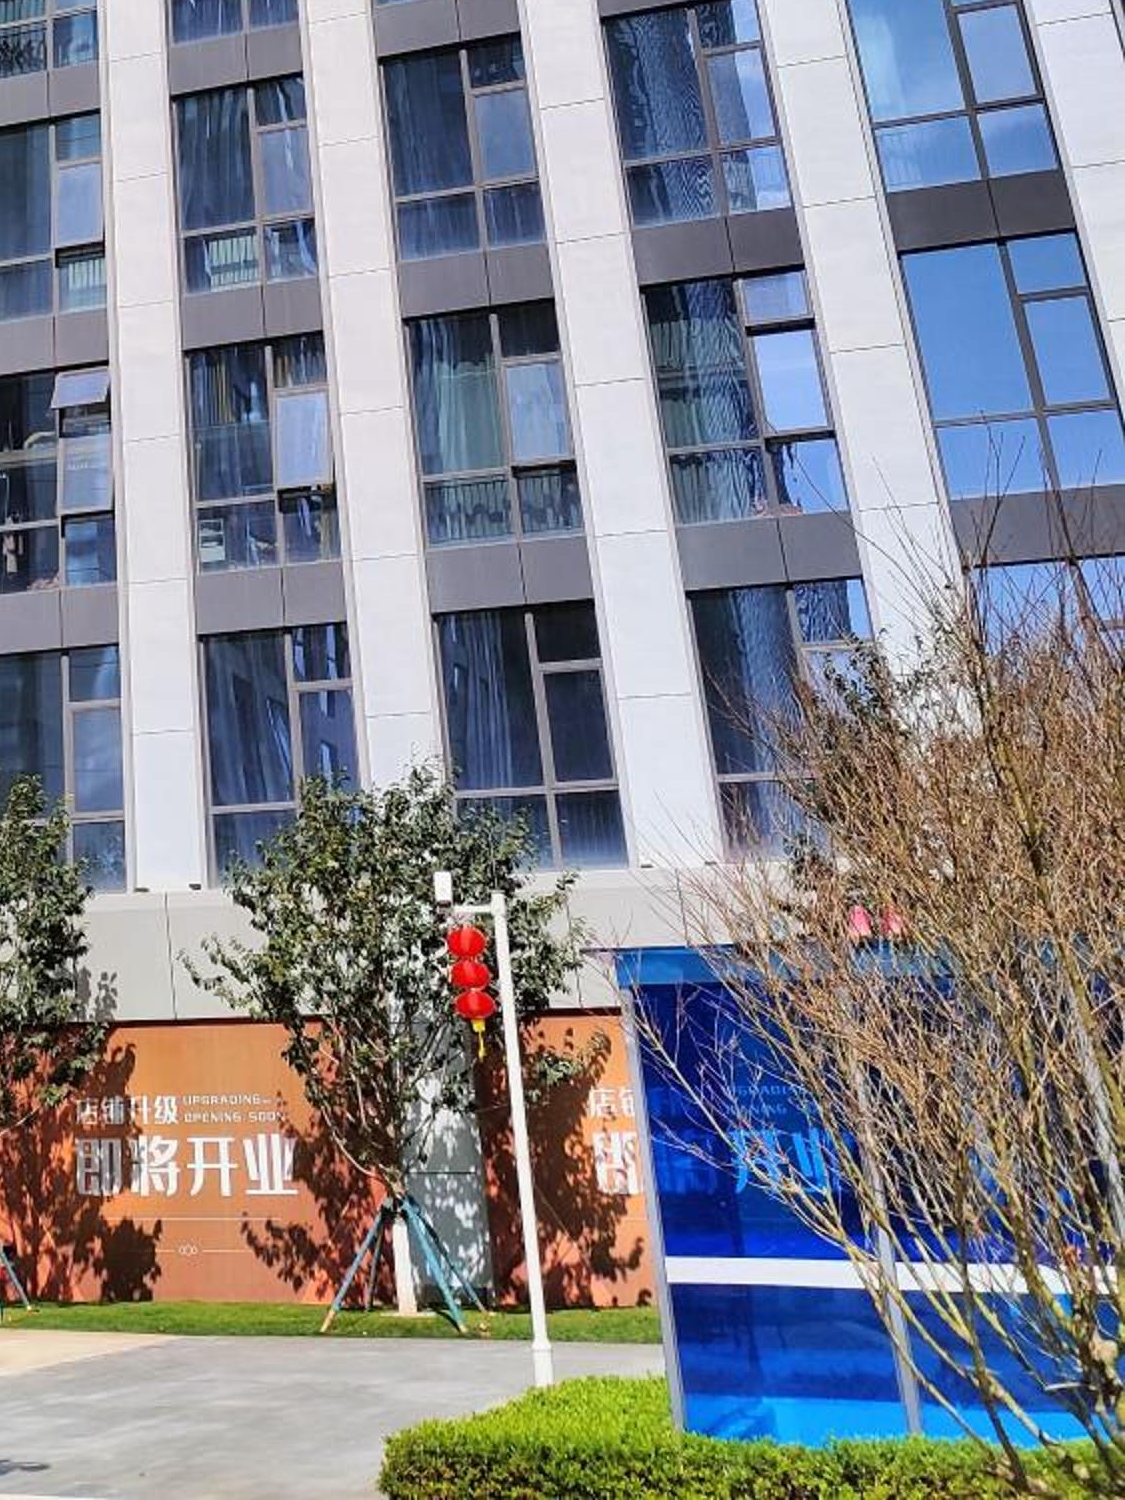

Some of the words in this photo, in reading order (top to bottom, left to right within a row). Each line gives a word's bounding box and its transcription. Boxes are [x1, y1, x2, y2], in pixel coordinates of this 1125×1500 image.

[76, 1095, 178, 1124] 店铺升级
[184, 1112, 242, 1122] OPENING
[249, 1111, 284, 1122] SOON
[75, 1133, 299, 1197] 即将开业
